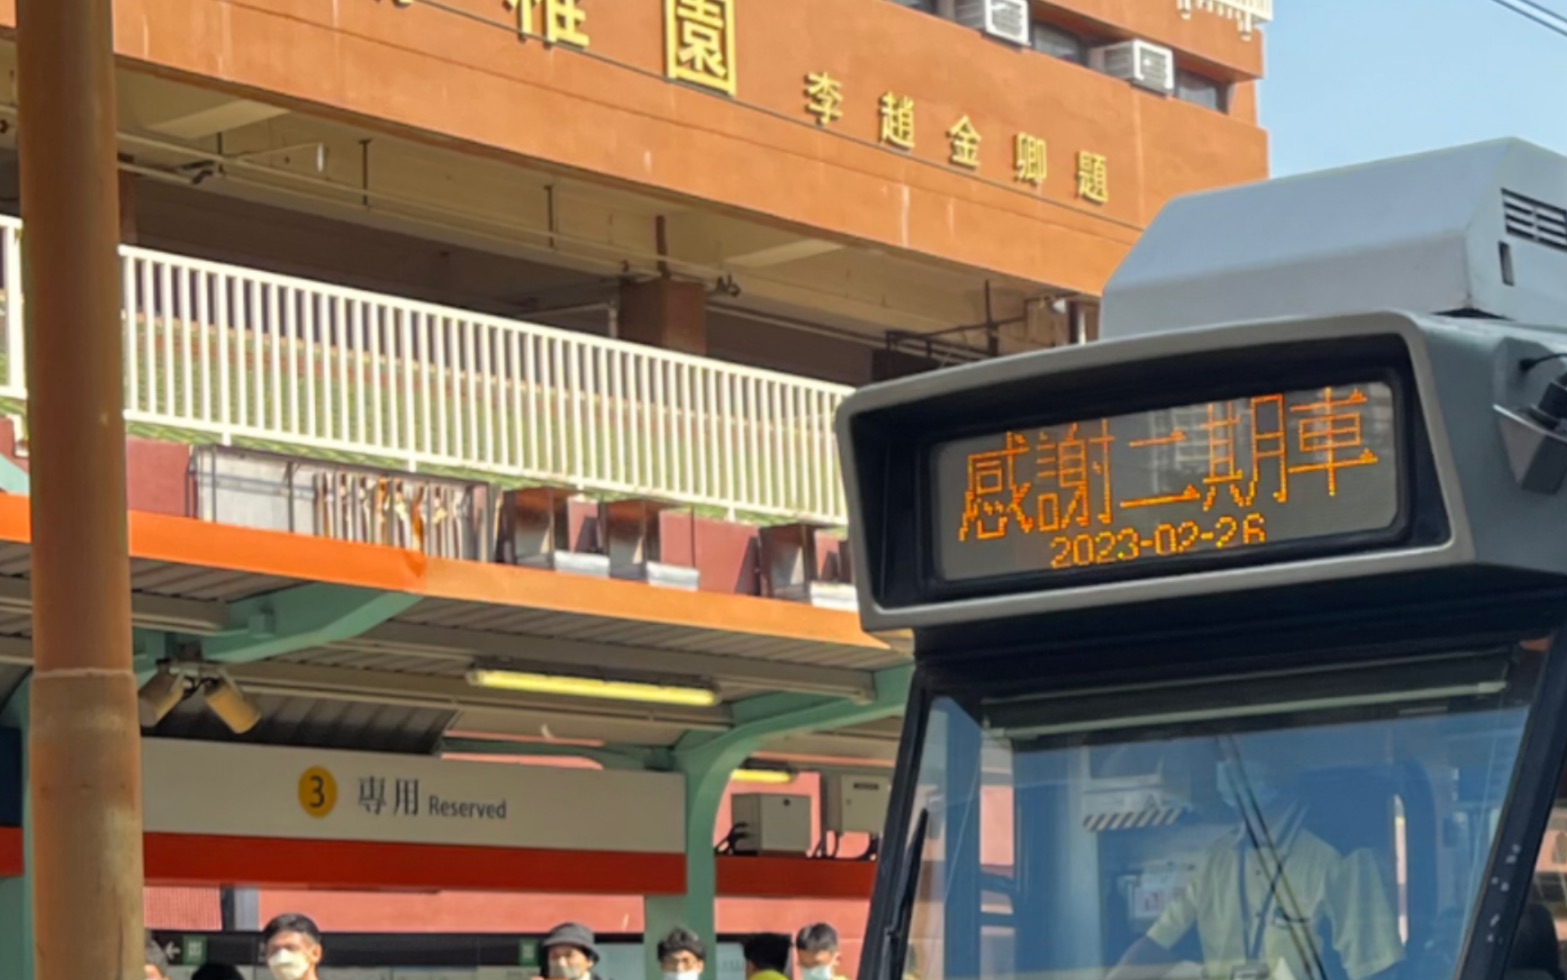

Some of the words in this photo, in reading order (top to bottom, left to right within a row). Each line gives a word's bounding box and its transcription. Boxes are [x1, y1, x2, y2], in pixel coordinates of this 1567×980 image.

[804, 71, 1109, 206] 李趙金卿題
[958, 386, 1379, 542] 感謝二期車
[1049, 512, 1267, 569] 2023-02-26
[308, 775, 325, 808] 3
[428, 795, 508, 819] Reserved
